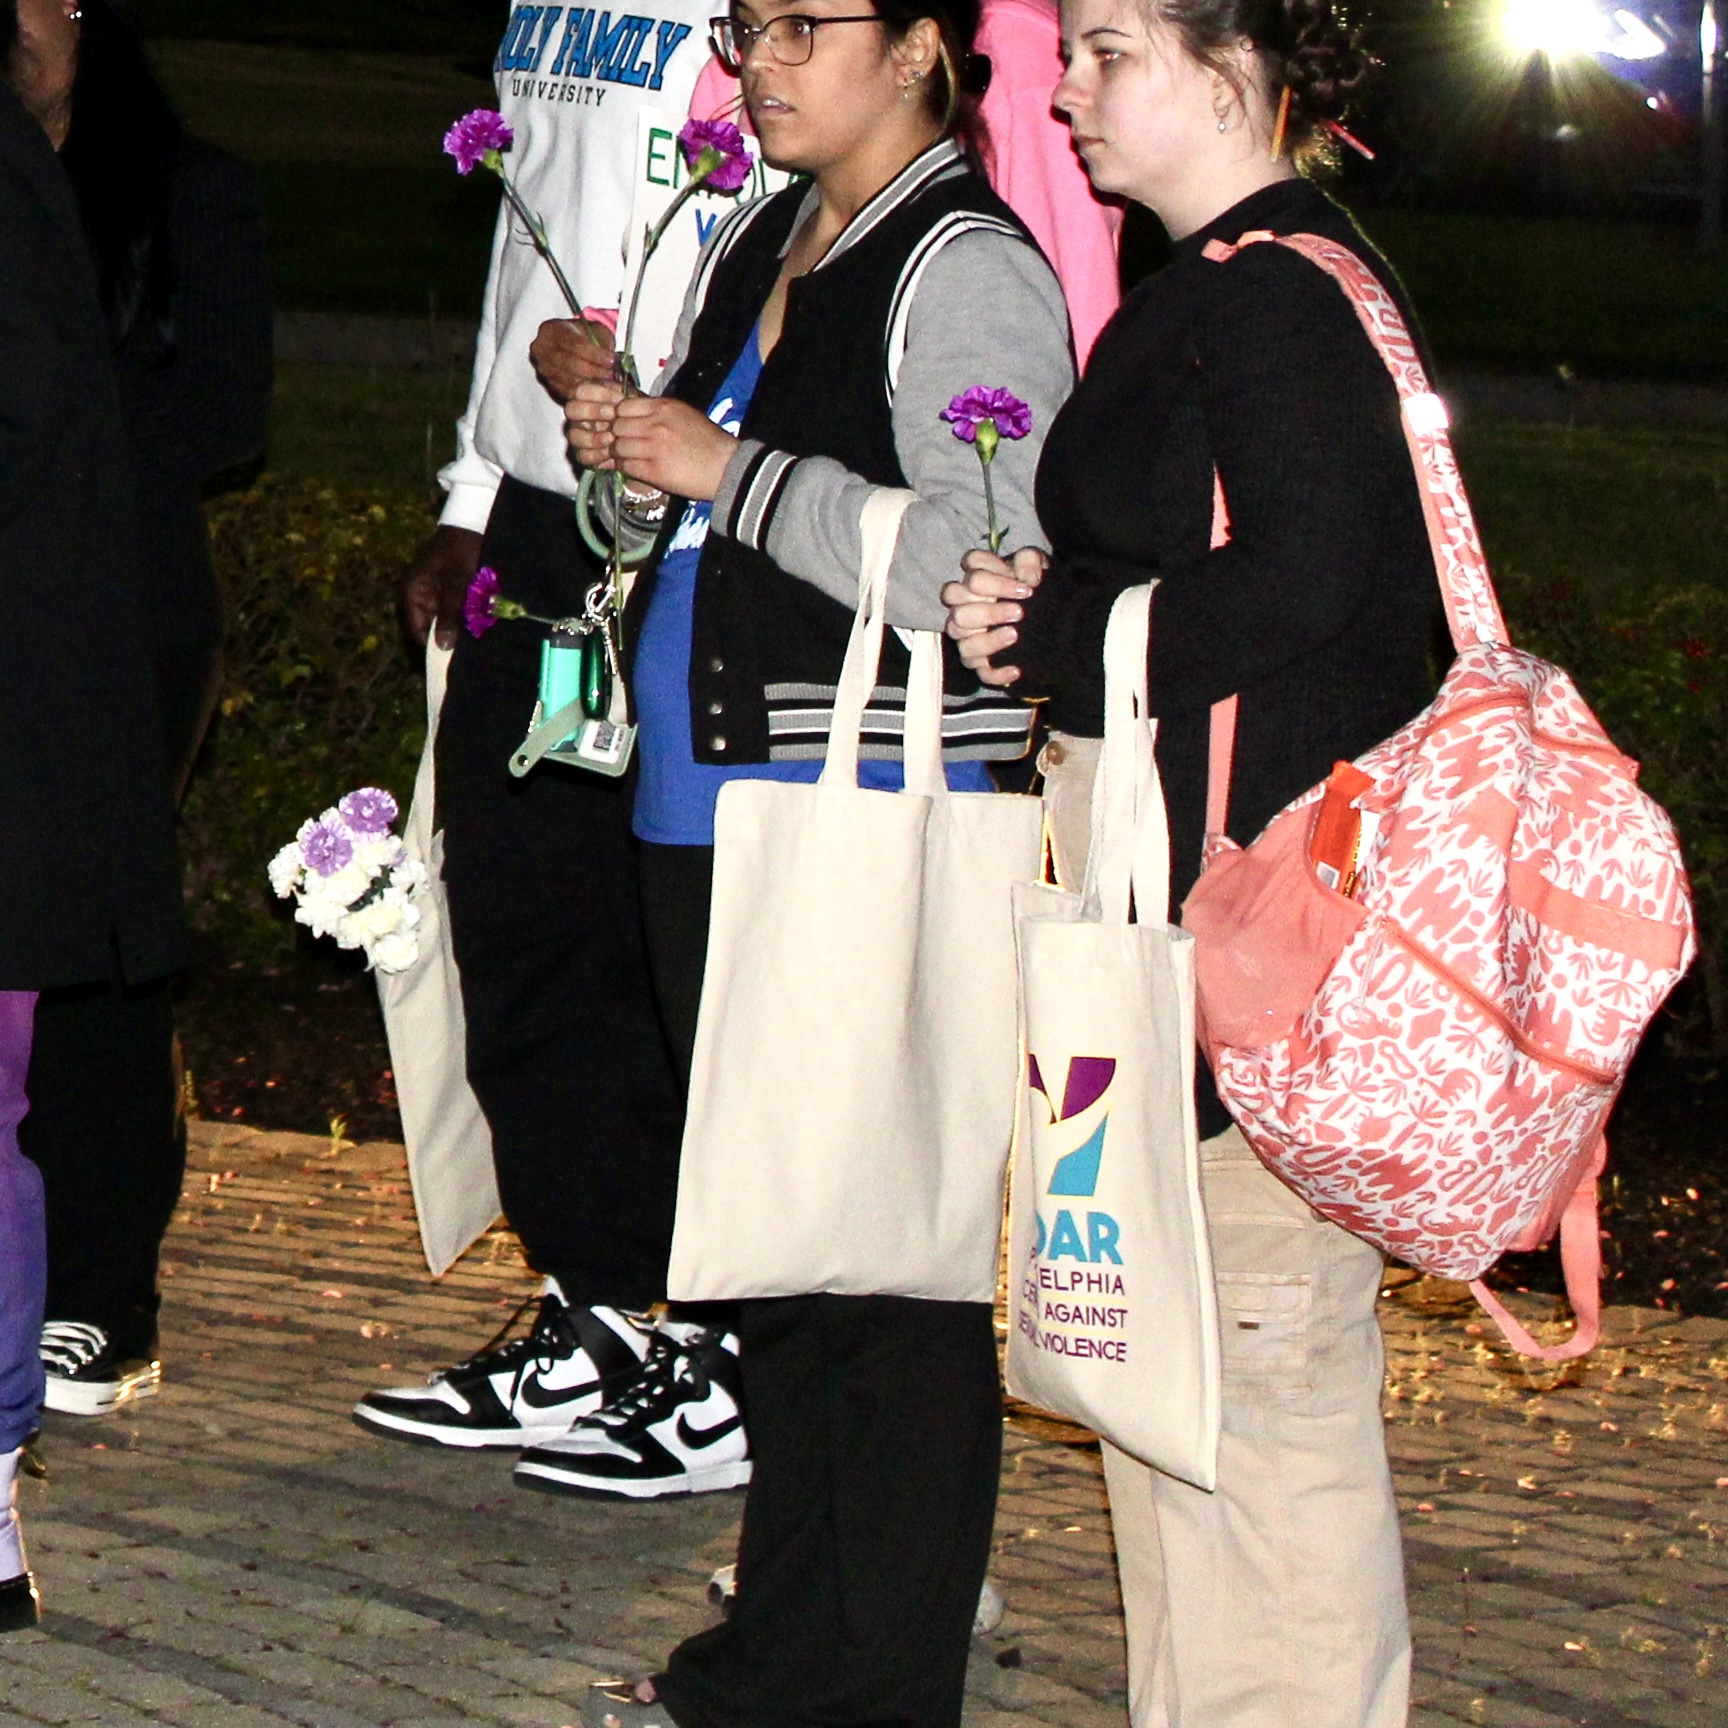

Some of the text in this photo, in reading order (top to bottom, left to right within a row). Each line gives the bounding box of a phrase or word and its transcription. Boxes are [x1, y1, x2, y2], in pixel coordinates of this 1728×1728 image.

[494, 5, 693, 91] OLY FAMILY
[512, 79, 606, 107] UNIVERSITY
[1045, 1302, 1128, 1328] AGAINST
[1039, 1332, 1127, 1363] VIOLENCE
